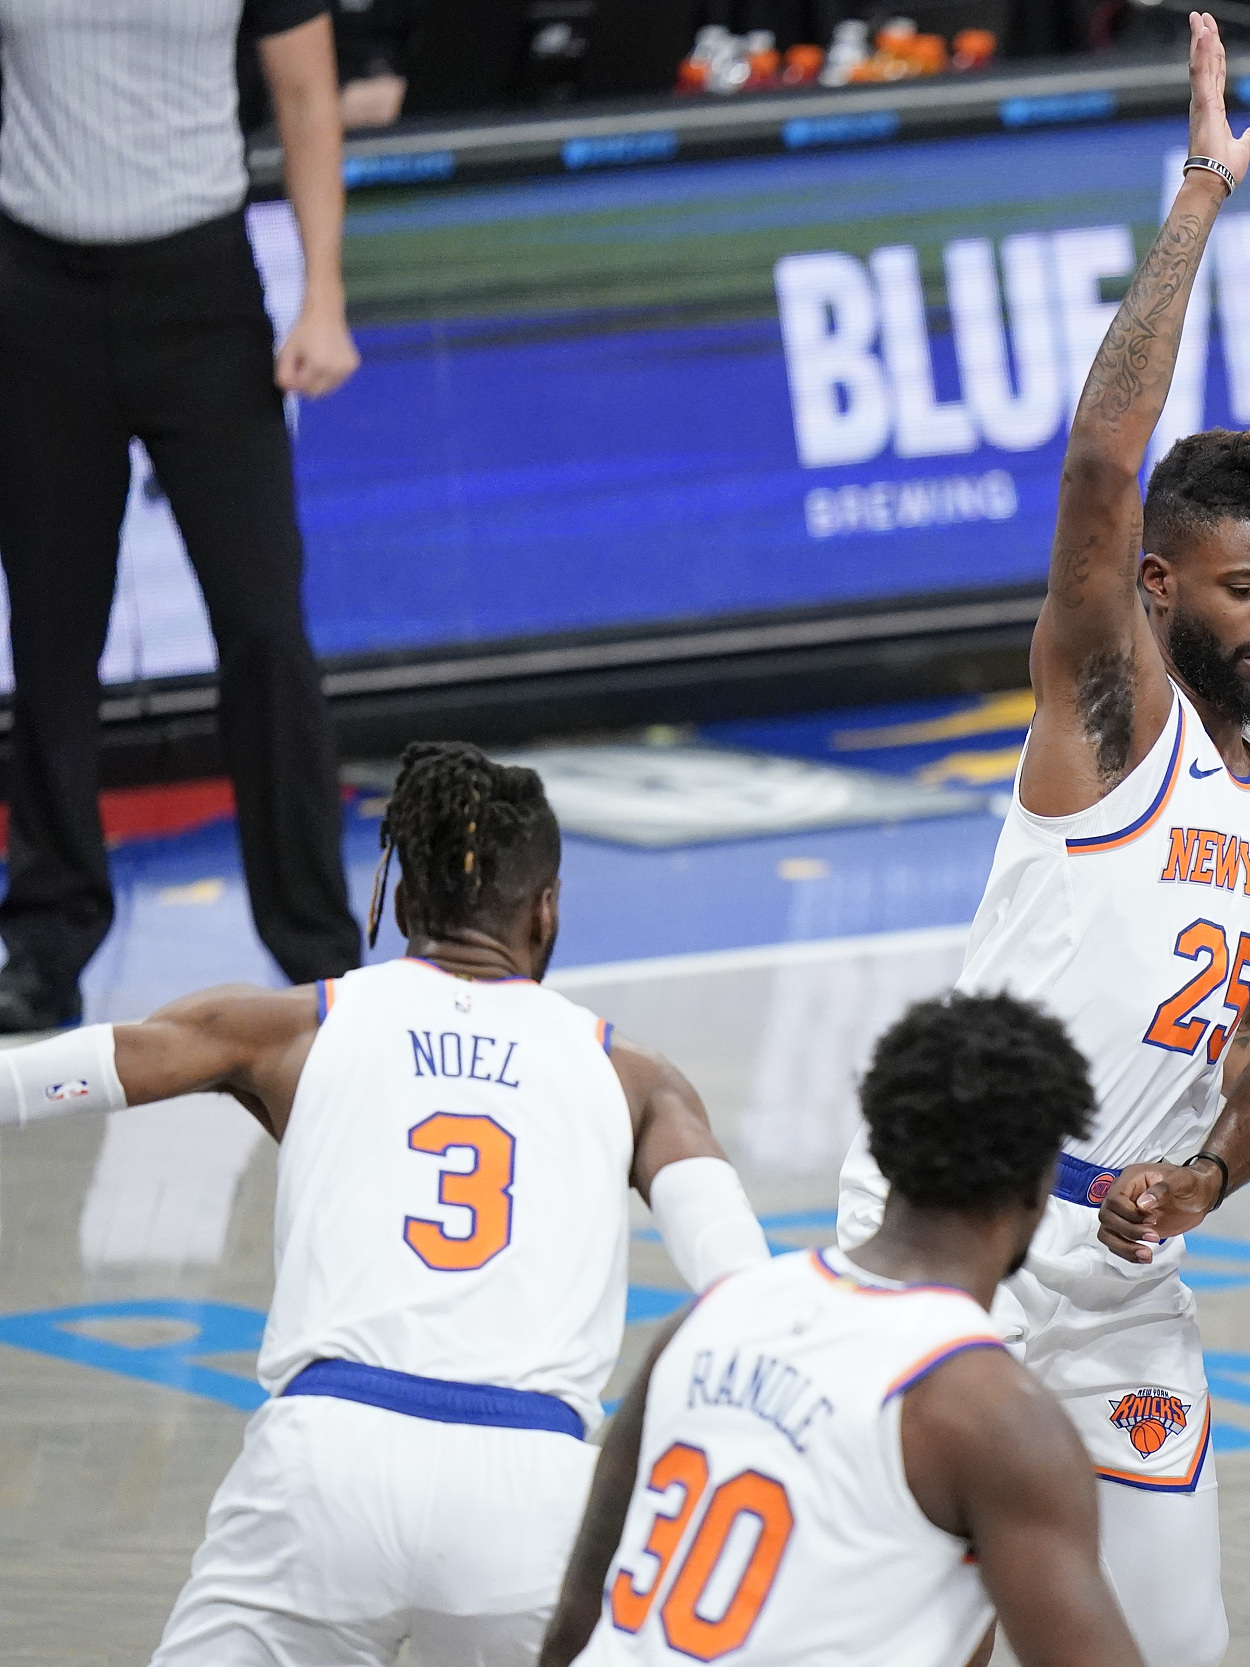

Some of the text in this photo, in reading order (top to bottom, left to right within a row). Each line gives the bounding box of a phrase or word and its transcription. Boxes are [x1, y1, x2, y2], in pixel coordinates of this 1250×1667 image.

[804, 469, 1019, 539] BREWING
[1160, 827, 1239, 892] NEW
[407, 1030, 520, 1089] NOEL
[403, 1111, 516, 1272] 3
[686, 1346, 834, 1454] RANDLE
[1109, 1393, 1187, 1428] KNICKS
[608, 1441, 796, 1664] 30
